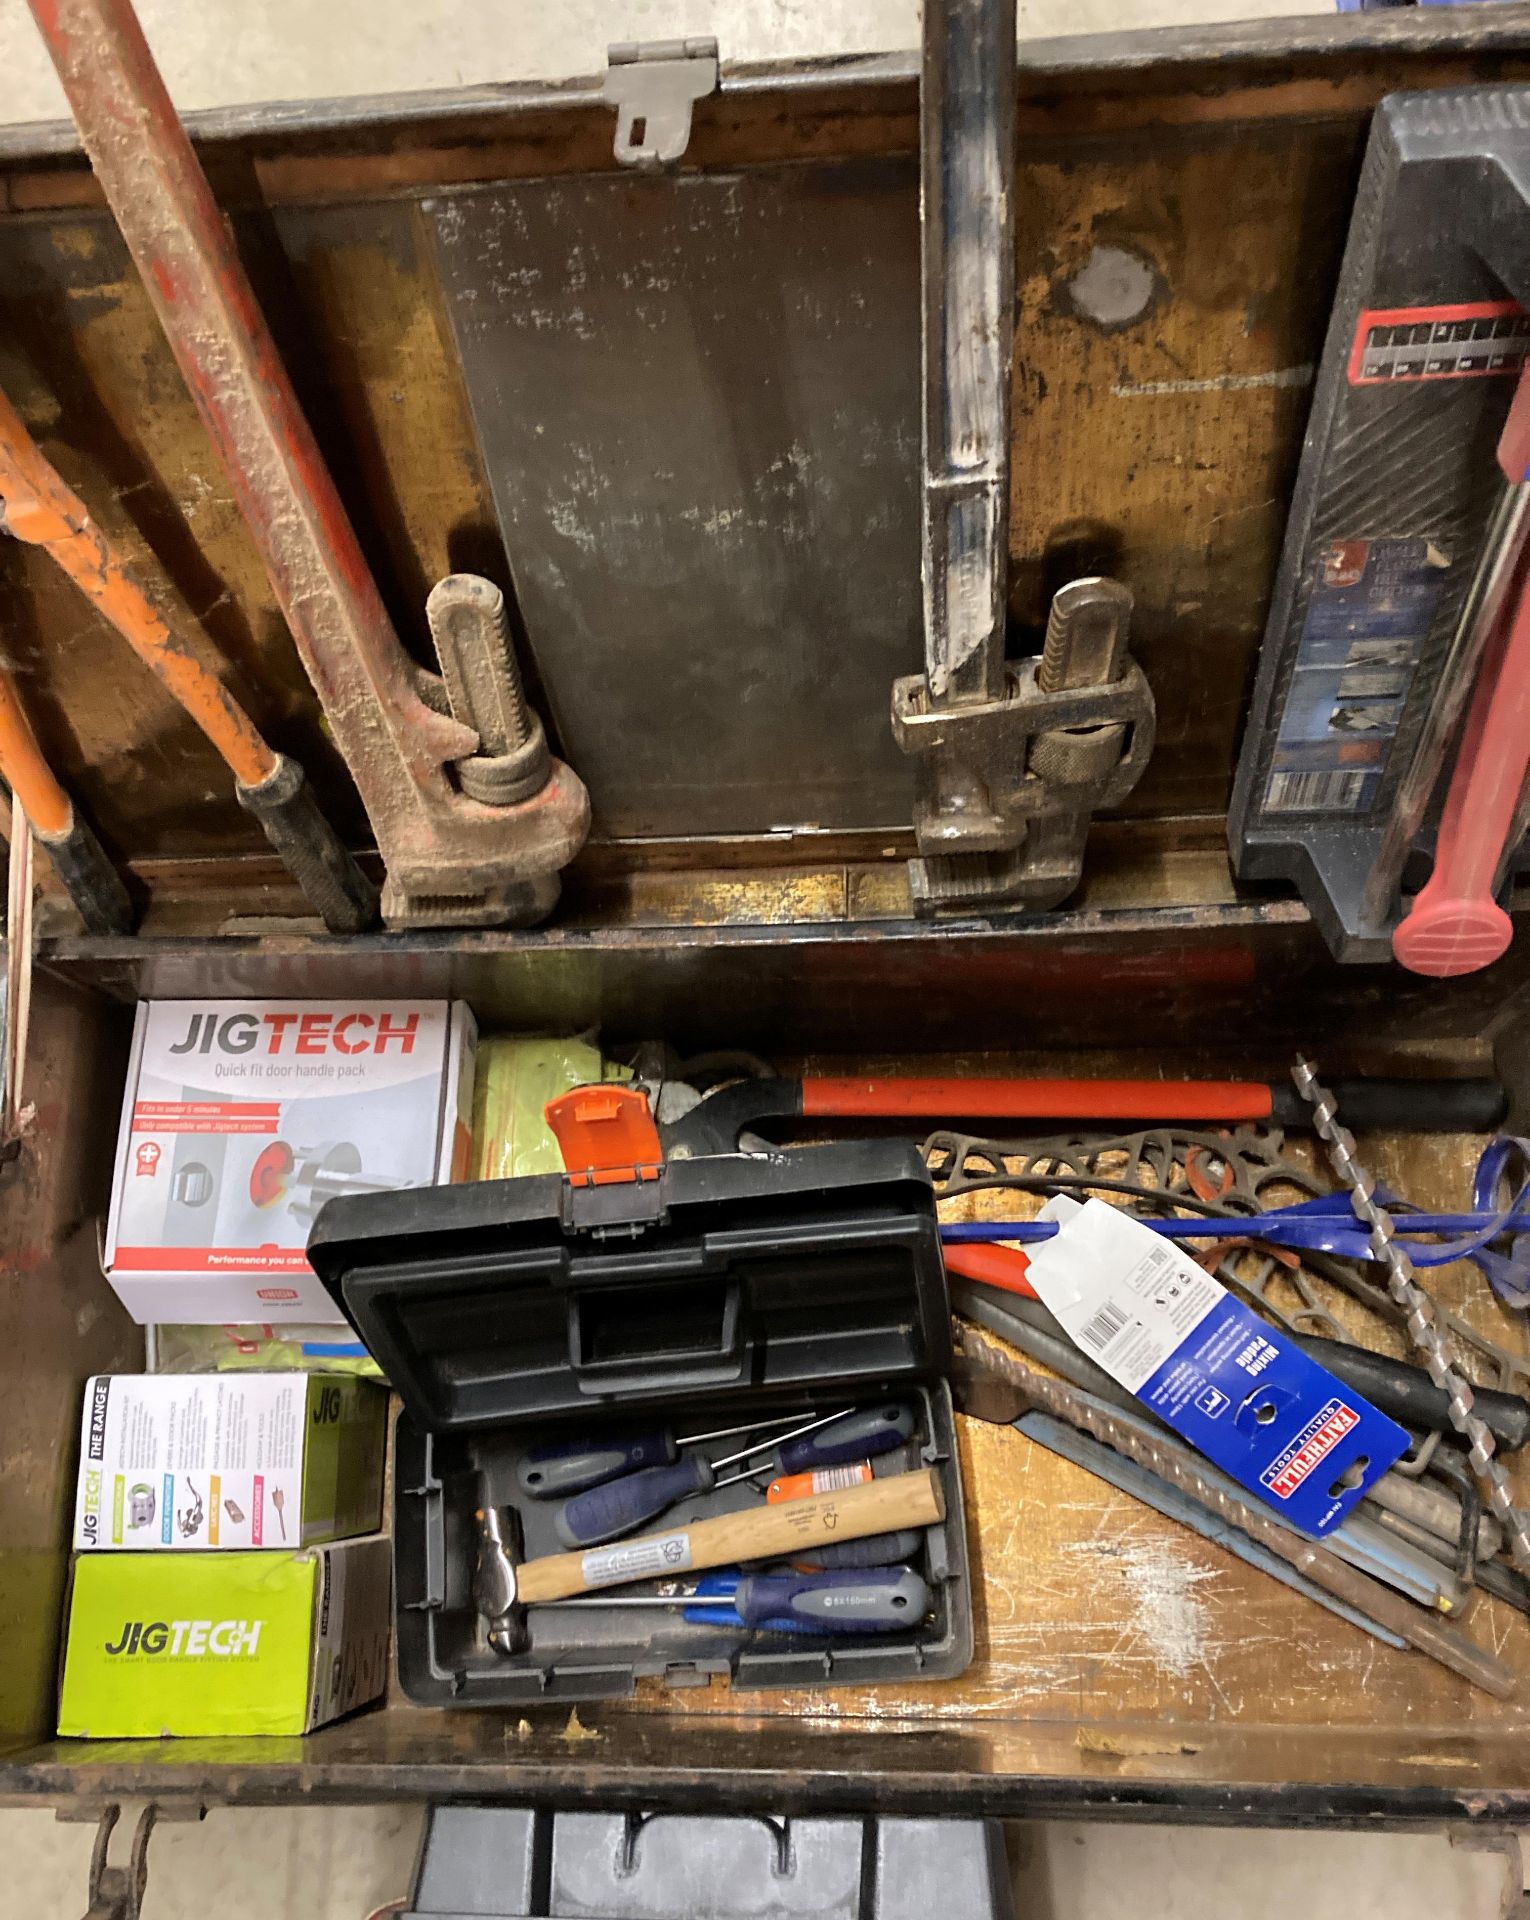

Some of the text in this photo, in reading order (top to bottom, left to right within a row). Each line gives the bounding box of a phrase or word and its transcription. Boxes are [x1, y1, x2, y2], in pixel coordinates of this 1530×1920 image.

[169, 1013, 420, 1055] JIGTECH
[215, 1063, 365, 1080] Quick fit door handle pack
[208, 1254, 303, 1267] Performance you can
[1234, 1335, 1268, 1368] Paddle
[1244, 1345, 1280, 1377] Mixing
[93, 1386, 107, 1431] RANGE
[90, 1434, 103, 1457] THE
[1267, 1405, 1336, 1478] QUALITY TOOLS
[1276, 1411, 1354, 1491] FAITHFULL
[83, 1470, 98, 1545] JIGTECH
[105, 1620, 263, 1656] JIGTECH
